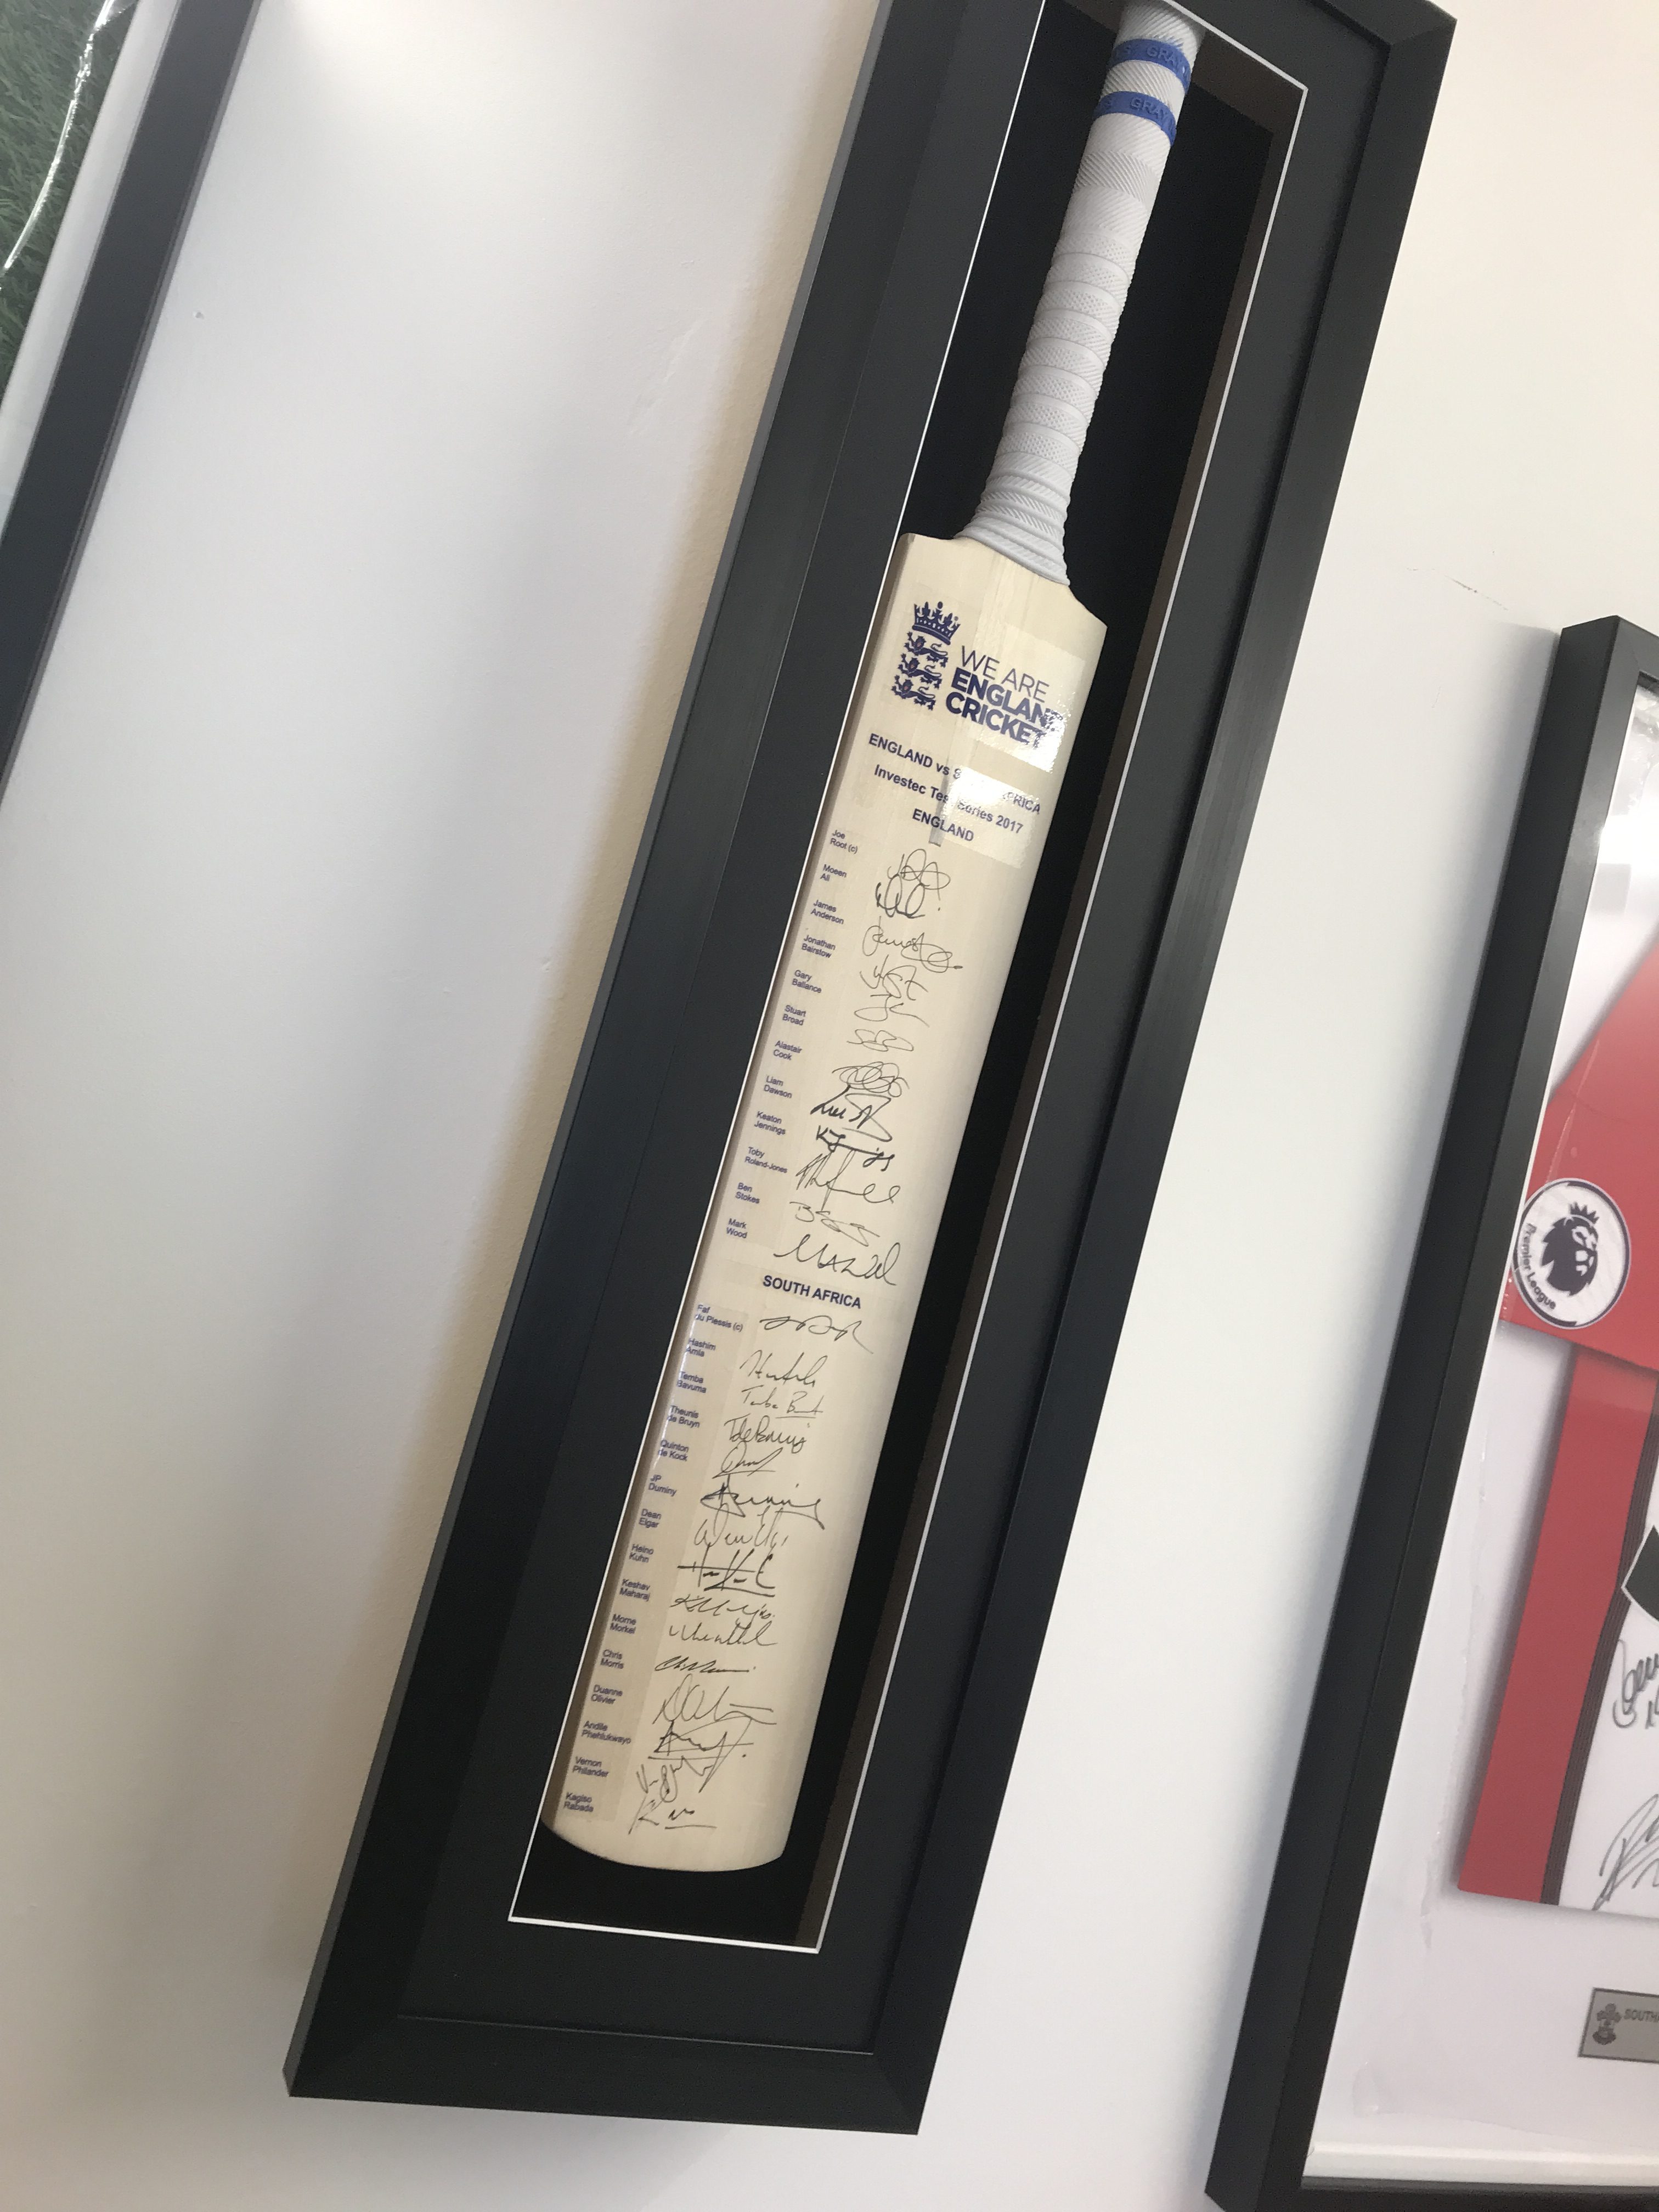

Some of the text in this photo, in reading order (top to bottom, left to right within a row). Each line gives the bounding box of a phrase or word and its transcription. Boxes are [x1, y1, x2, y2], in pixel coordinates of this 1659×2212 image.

[962, 645, 1049, 703] WE ARE
[946, 692, 1048, 749] CRICKET
[869, 733, 933, 768] ENGLAND
[936, 763, 950, 775] vs
[874, 764, 926, 794] Investec
[930, 787, 949, 804] Tes
[996, 815, 1023, 833] 2017
[912, 808, 974, 841] ENGLAND
[832, 830, 845, 839] Joe
[830, 838, 858, 854] Root (c)
[820, 873, 830, 882] Ali
[823, 864, 847, 878] Moeen
[814, 900, 837, 912] James
[810, 909, 844, 924] Anderson
[804, 935, 836, 950] Jonathan
[802, 943, 832, 958] Bairstow
[794, 969, 812, 982] Gary
[792, 979, 822, 993] Ballance
[785, 1005, 806, 1017] Stuart
[782, 1014, 804, 1026] Broad
[775, 1040, 803, 1053] Alastair
[773, 1049, 792, 1060] Cook
[766, 1075, 783, 1086] Liam
[764, 1084, 792, 1098] Dawson
[756, 1111, 782, 1124] Keaton
[754, 1121, 786, 1135] Jennings
[748, 1147, 765, 1158] Toby
[744, 1156, 788, 1173] Roland-Jones
[737, 1182, 752, 1192] Ben
[735, 1192, 760, 1204] Stokes
[729, 1218, 747, 1229] Mark
[726, 1227, 748, 1238] Wood
[763, 1275, 861, 1309] SOUTH AFRICA
[706, 1316, 731, 1328] Plessis
[733, 1322, 743, 1332] (c)
[689, 1338, 716, 1351] Hashim
[686, 1346, 704, 1357] Amla
[680, 1372, 703, 1383] Temba
[671, 1405, 699, 1419] Theunis
[679, 1417, 700, 1428] Bruyn
[661, 1440, 689, 1453] Quinton
[669, 1451, 687, 1462] Kock
[648, 1482, 678, 1497] Duminy
[641, 1509, 662, 1520] Dean
[639, 1517, 659, 1528] Elgar
[629, 1552, 650, 1563] Kuhn
[603, 1649, 623, 1660] Chris
[600, 1658, 624, 1669] Morris
